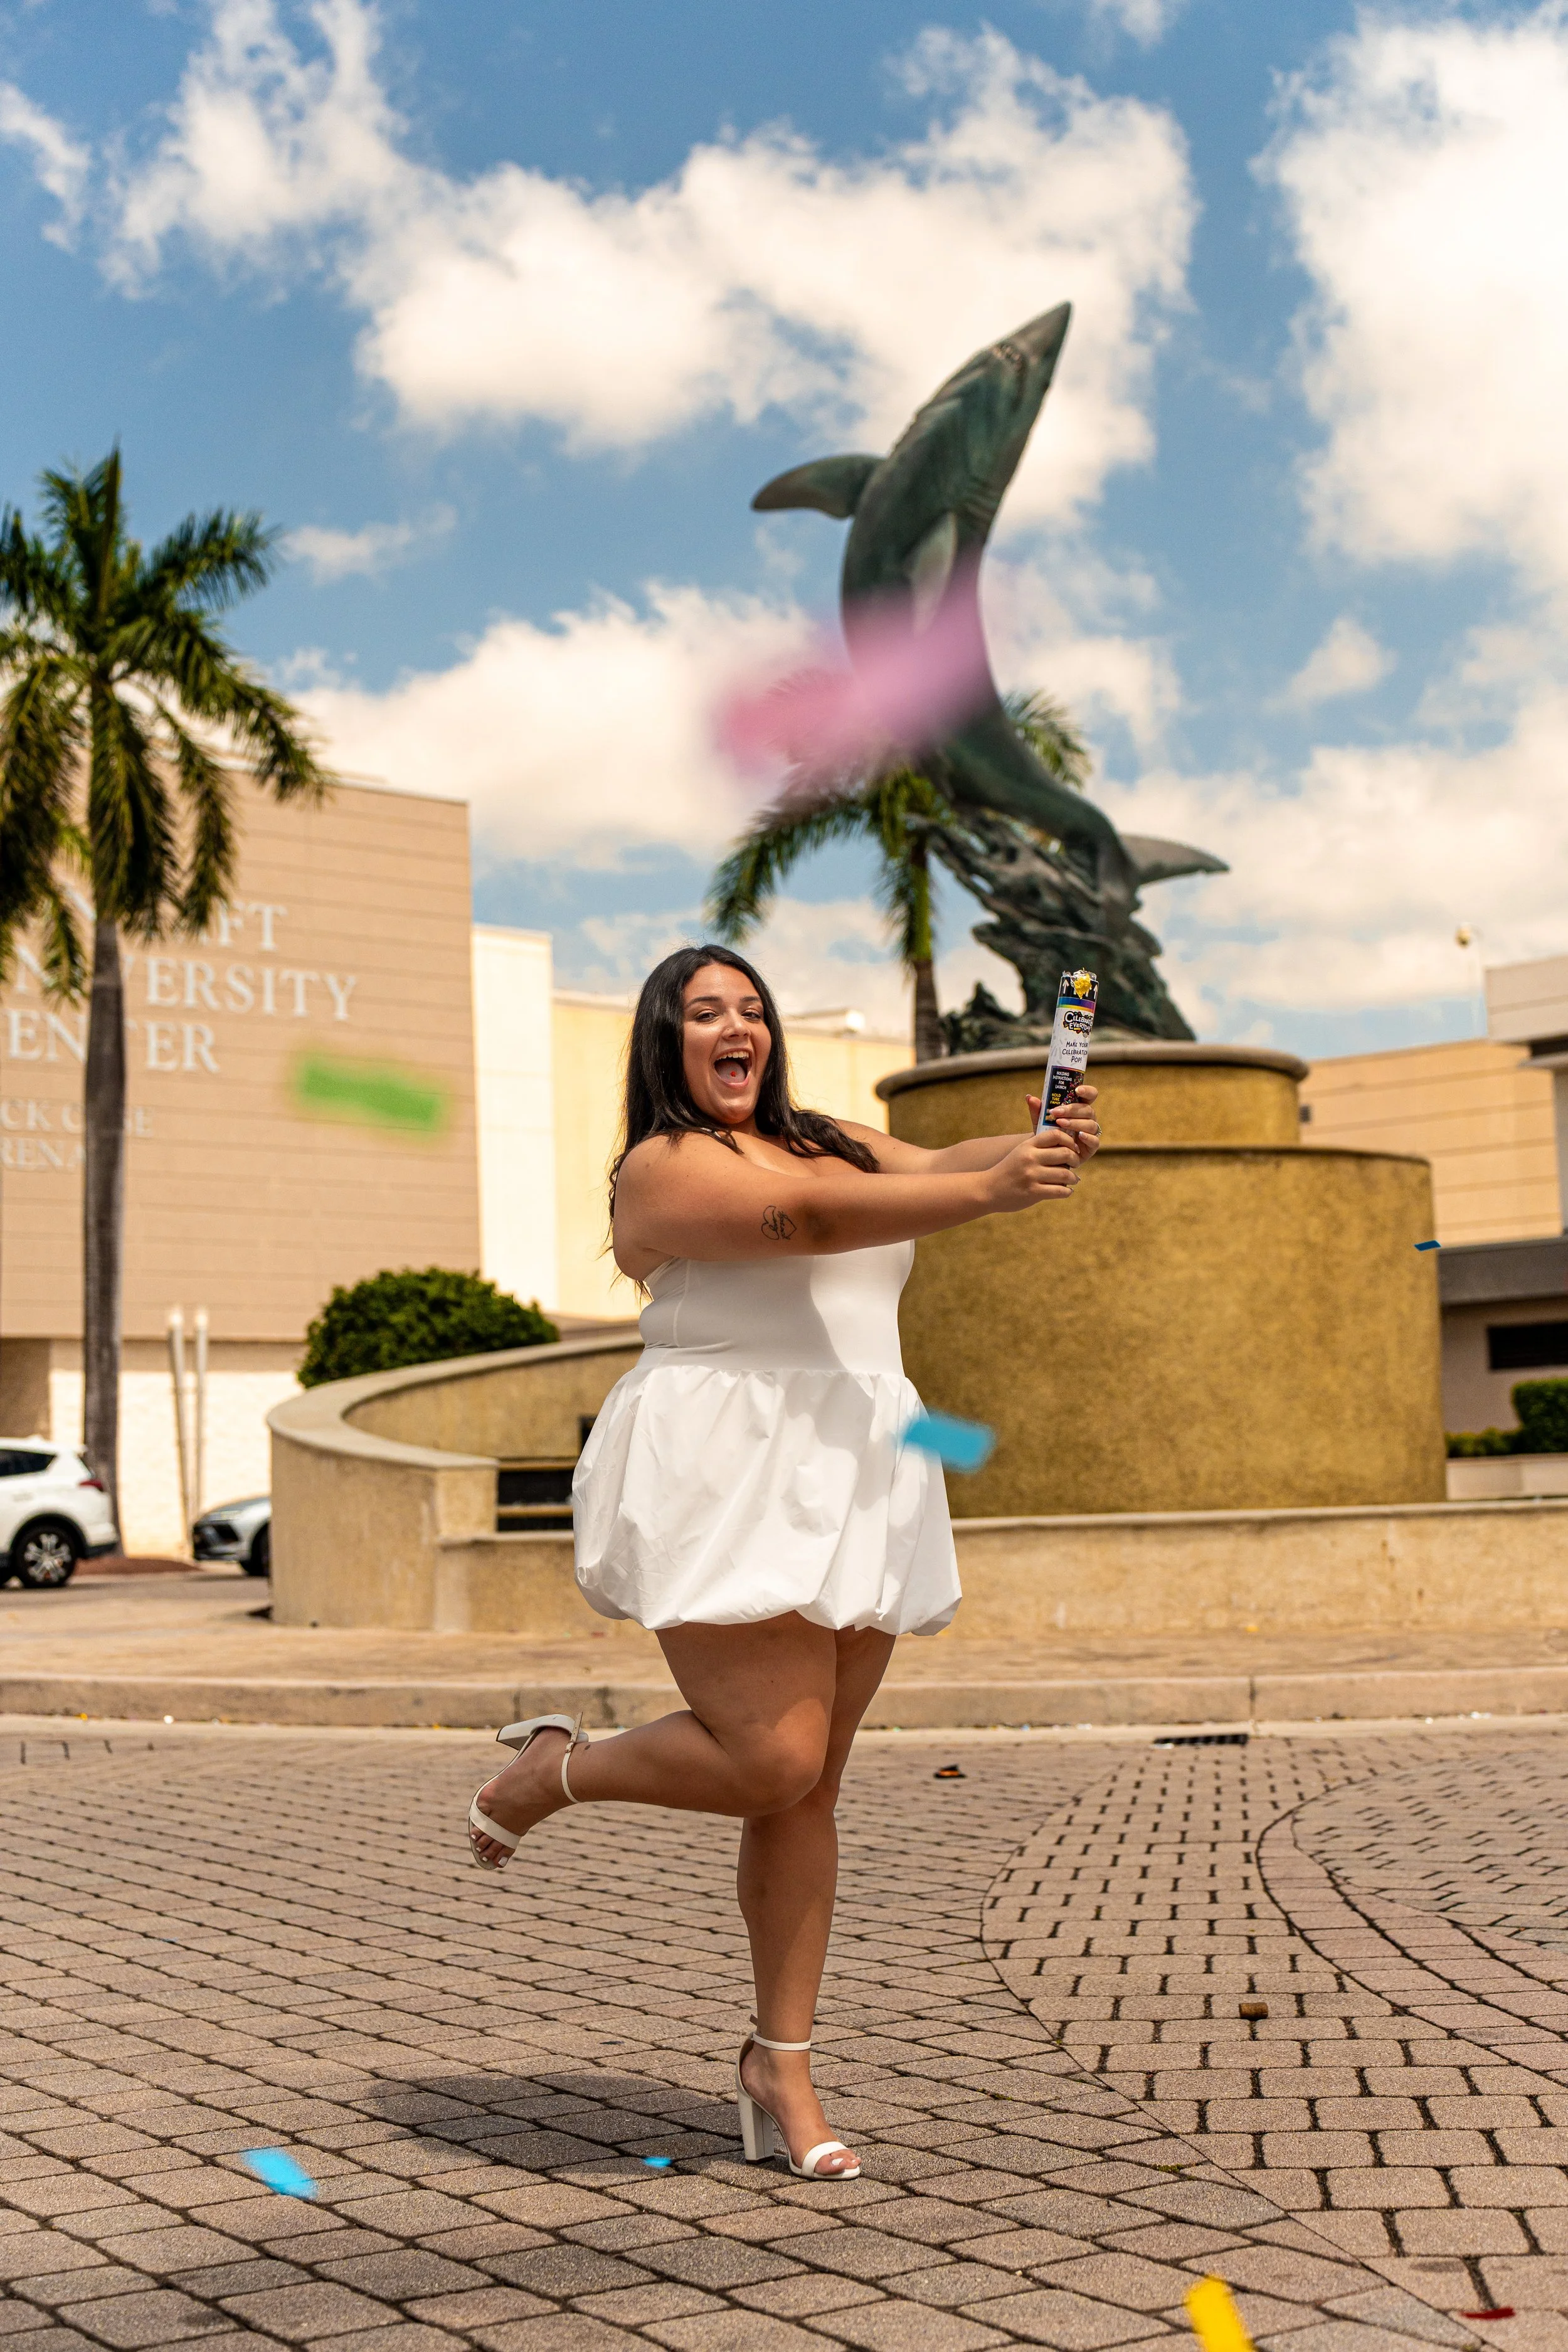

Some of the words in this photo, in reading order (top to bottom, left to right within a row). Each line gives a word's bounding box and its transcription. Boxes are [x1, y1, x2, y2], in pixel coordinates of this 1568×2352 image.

[11, 942, 357, 1022] NERSITY
[1065, 1011, 1093, 1027] CELEBRATE
[1069, 1022, 1091, 1032] EVERYDAY
[5, 1007, 221, 1074] ENER
